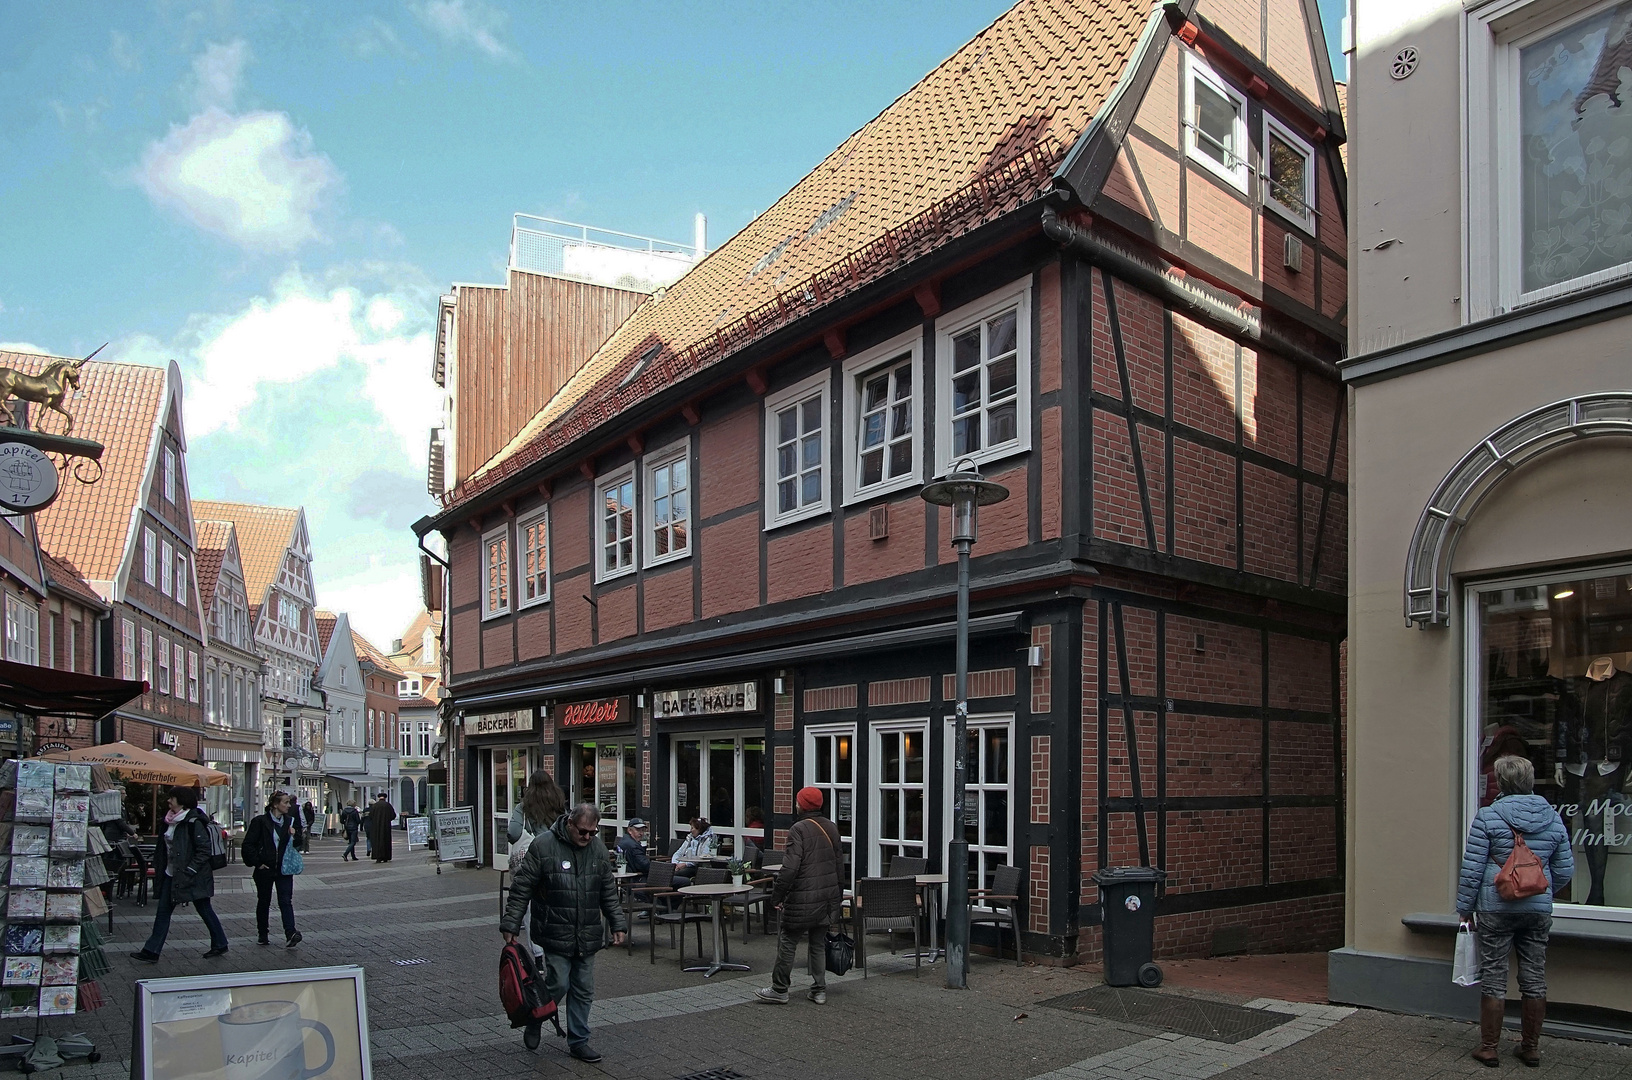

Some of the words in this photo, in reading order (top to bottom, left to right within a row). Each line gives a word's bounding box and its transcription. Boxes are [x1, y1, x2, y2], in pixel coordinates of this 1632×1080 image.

[11, 493, 31, 504] 17
[662, 692, 697, 715] CAFÉ
[703, 693, 745, 711] HAUS
[564, 699, 619, 726] Hillert
[477, 717, 517, 732] BÄCKEREI
[36, 742, 70, 756] RESTAURA
[226, 1048, 278, 1068] Kapitel
